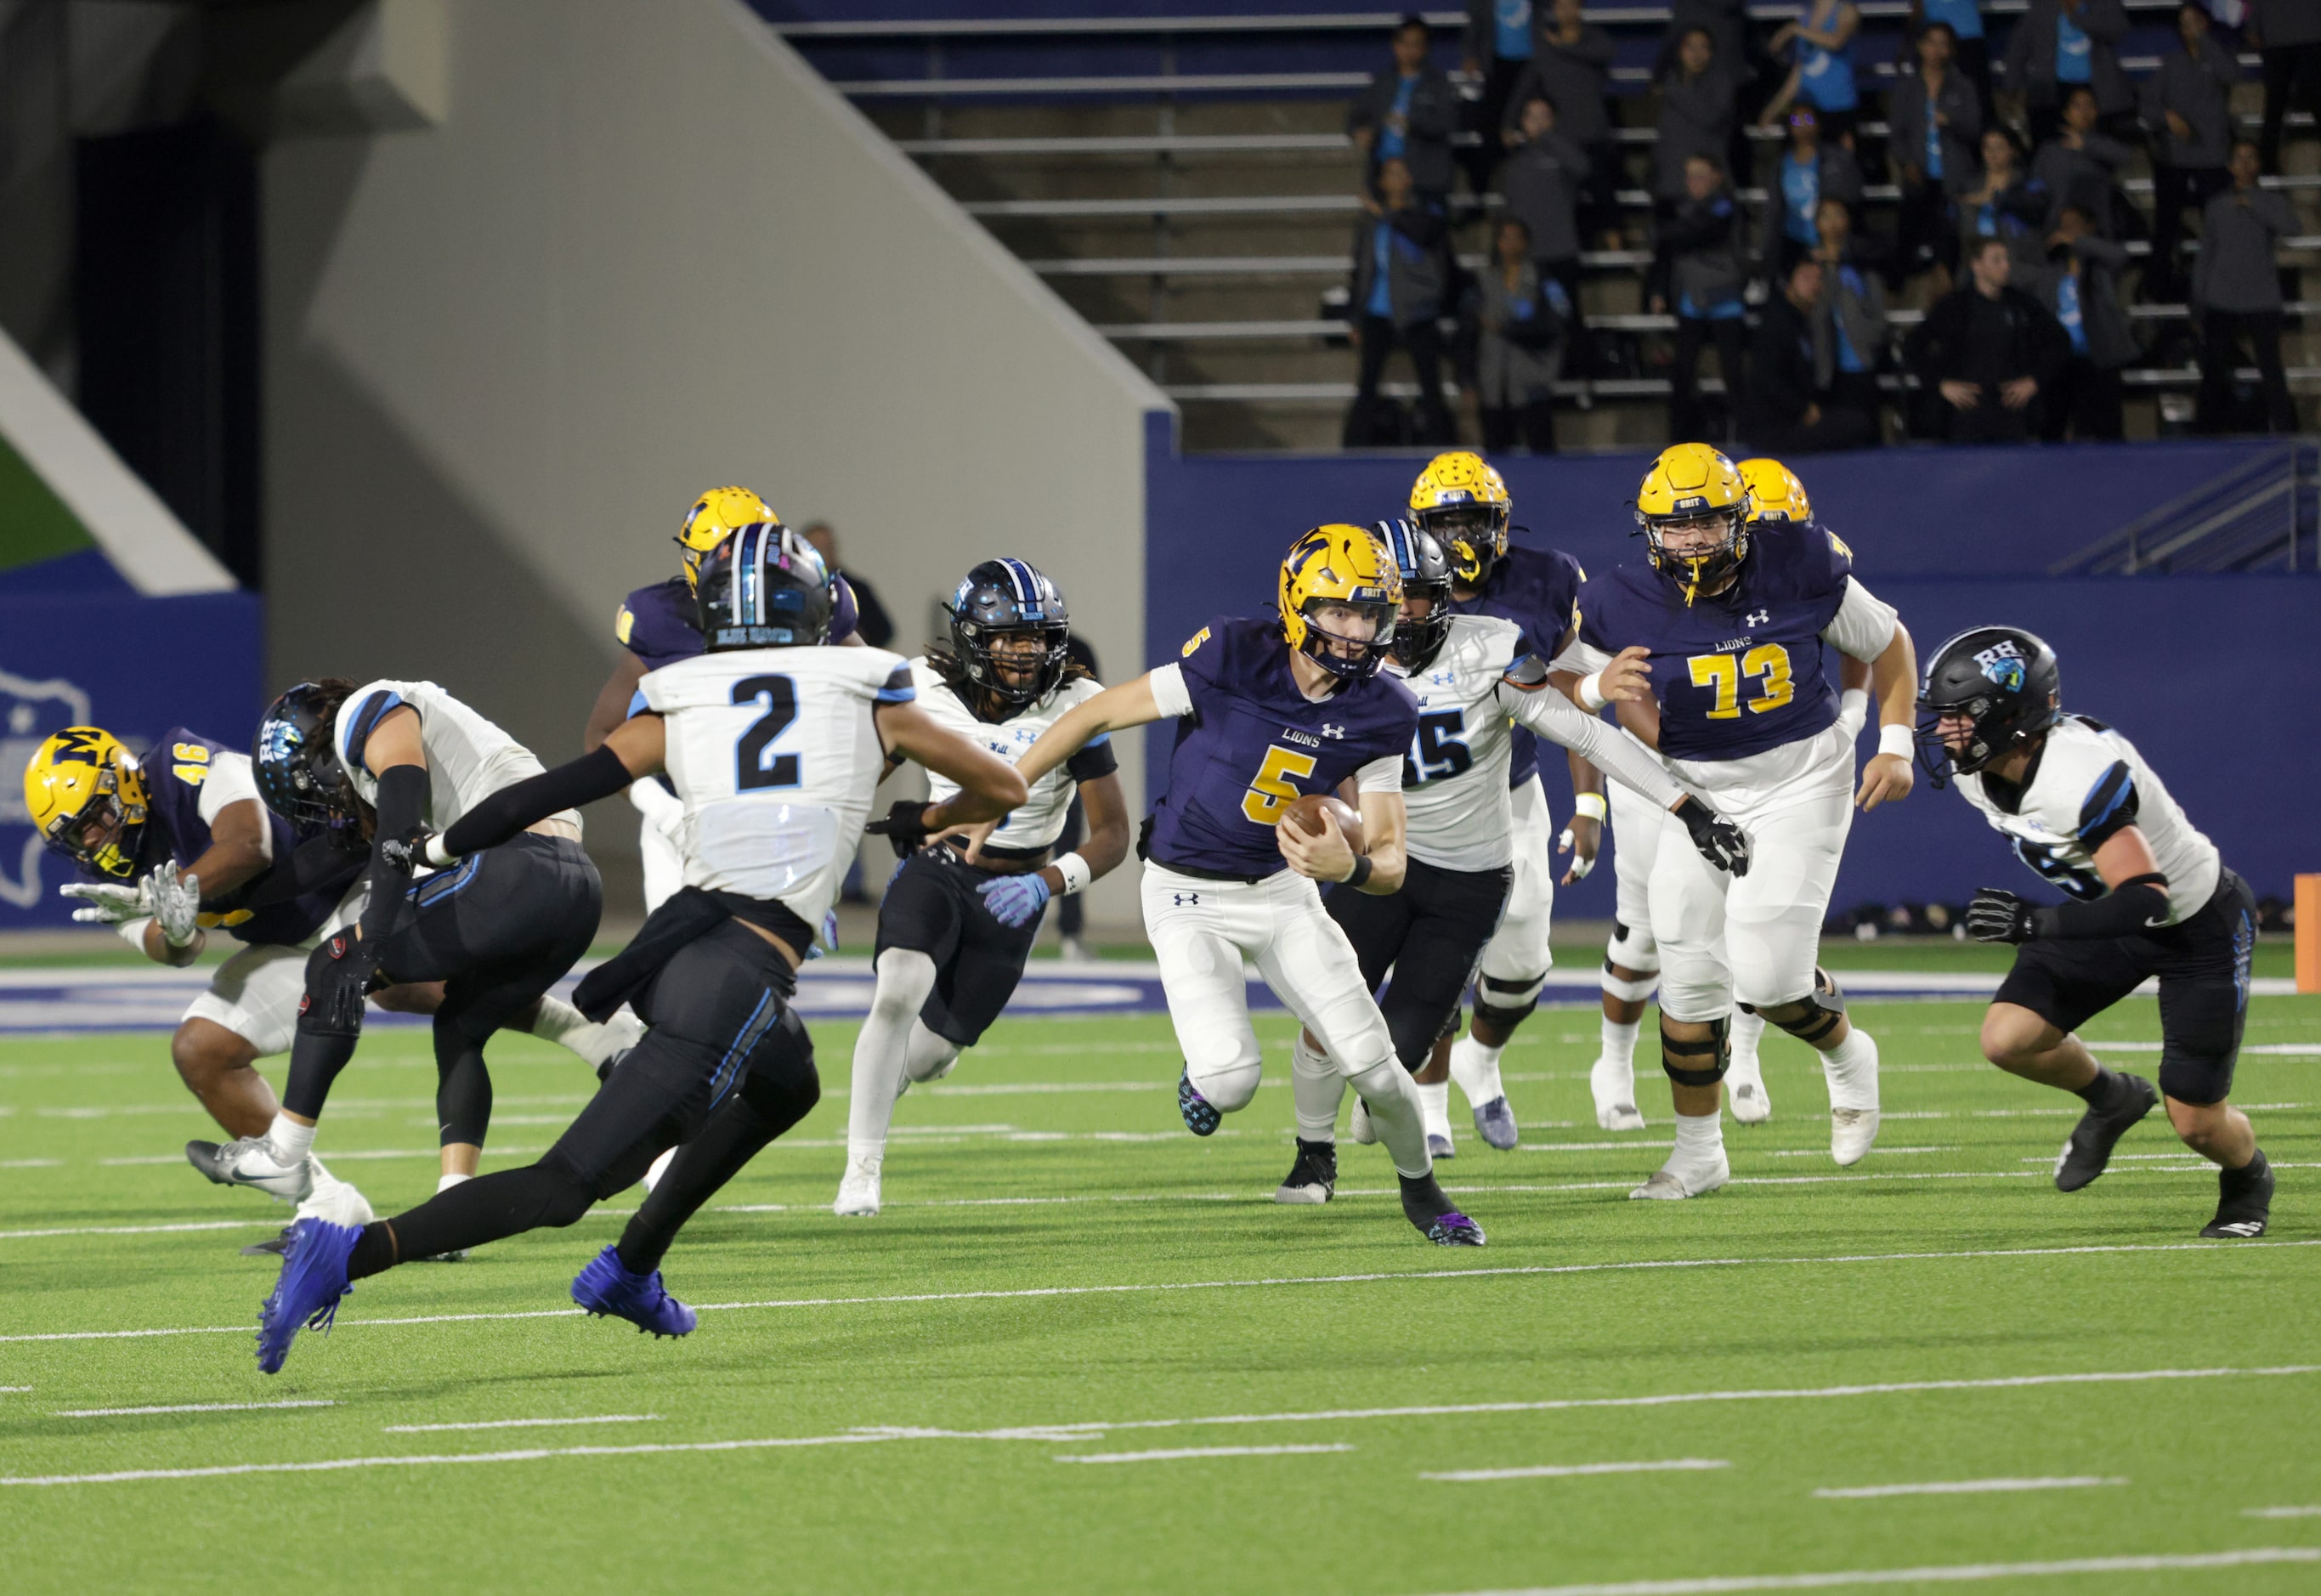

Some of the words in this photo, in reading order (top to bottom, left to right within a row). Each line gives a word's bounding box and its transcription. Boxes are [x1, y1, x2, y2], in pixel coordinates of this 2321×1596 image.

[1679, 497, 1700, 508] GRIT
[1361, 587, 1382, 598] GRIT
[1182, 626, 1211, 658] 5
[1716, 637, 1752, 652] LIONS
[1973, 640, 2024, 676] RH
[1687, 642, 1796, 719] 73
[729, 673, 802, 795] 2
[1282, 727, 1321, 748] LIONS
[173, 743, 209, 786] 46
[1241, 744, 1317, 826] 5
